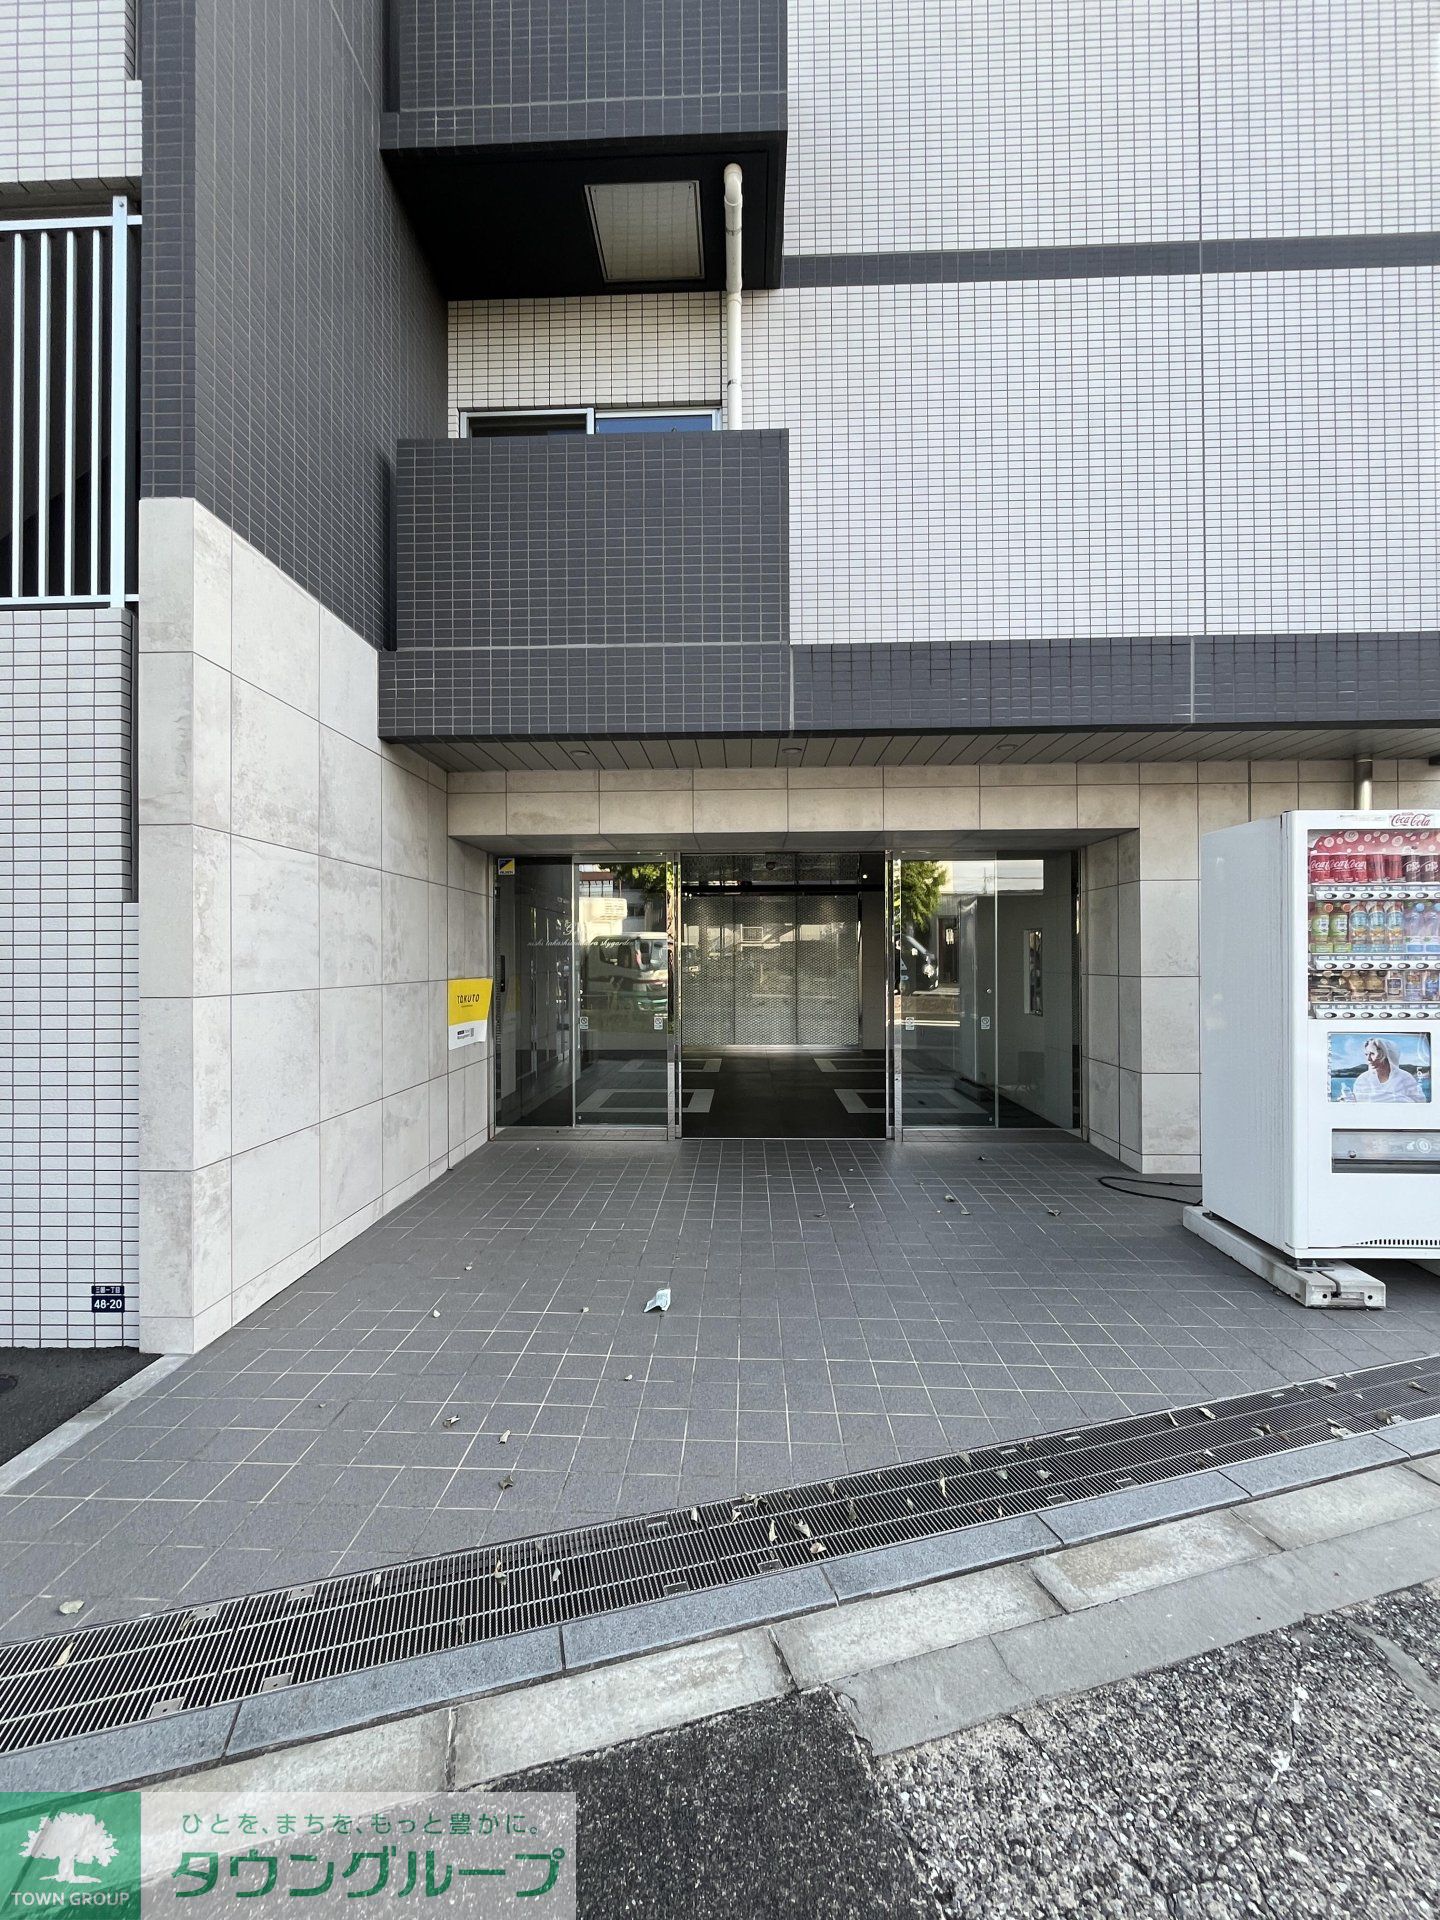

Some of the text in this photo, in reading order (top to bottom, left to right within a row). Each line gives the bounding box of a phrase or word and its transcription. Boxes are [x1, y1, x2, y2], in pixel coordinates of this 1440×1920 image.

[95, 1286, 121, 1294] 三一丁目
[94, 1299, 122, 1309] 48-20
